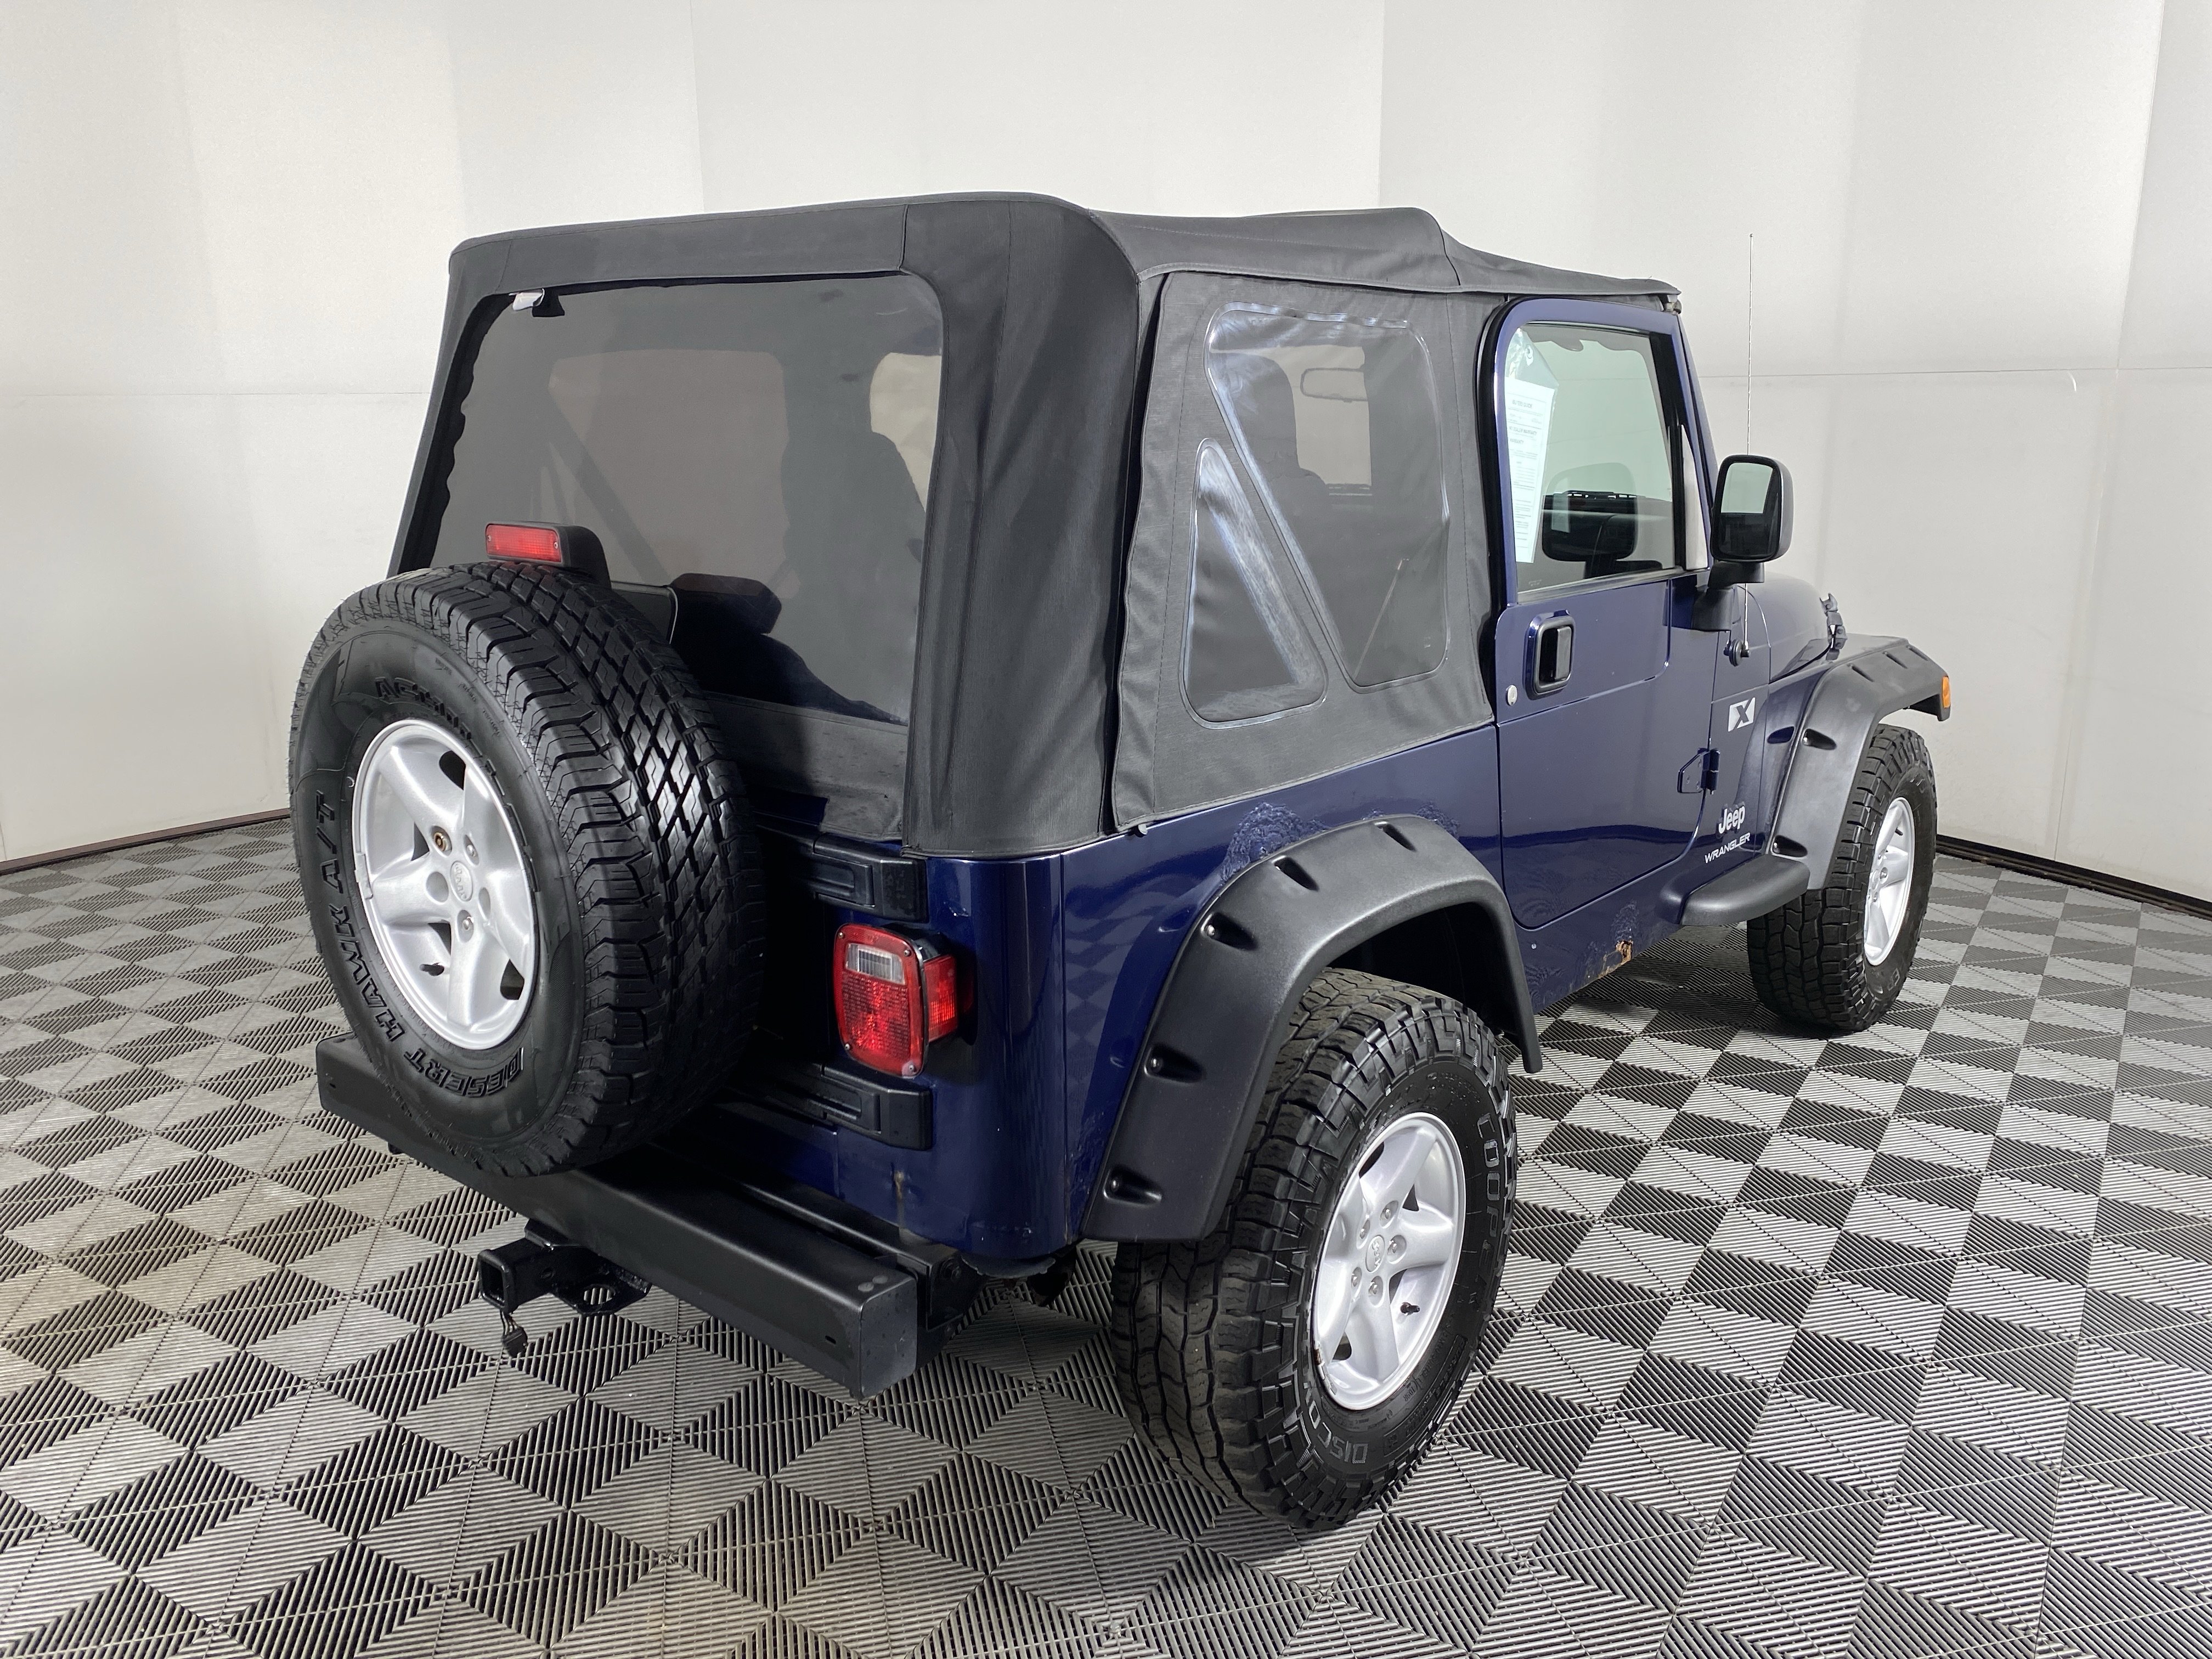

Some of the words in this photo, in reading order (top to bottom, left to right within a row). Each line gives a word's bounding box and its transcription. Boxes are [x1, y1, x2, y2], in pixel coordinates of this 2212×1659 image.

[1728, 697, 1756, 732] X
[1718, 805, 1746, 834] Jeep
[315, 790, 343, 894] A/T
[1704, 832, 1751, 864] WRANGLER
[329, 905, 405, 1042] HAWK
[404, 1047, 524, 1098] DESERT
